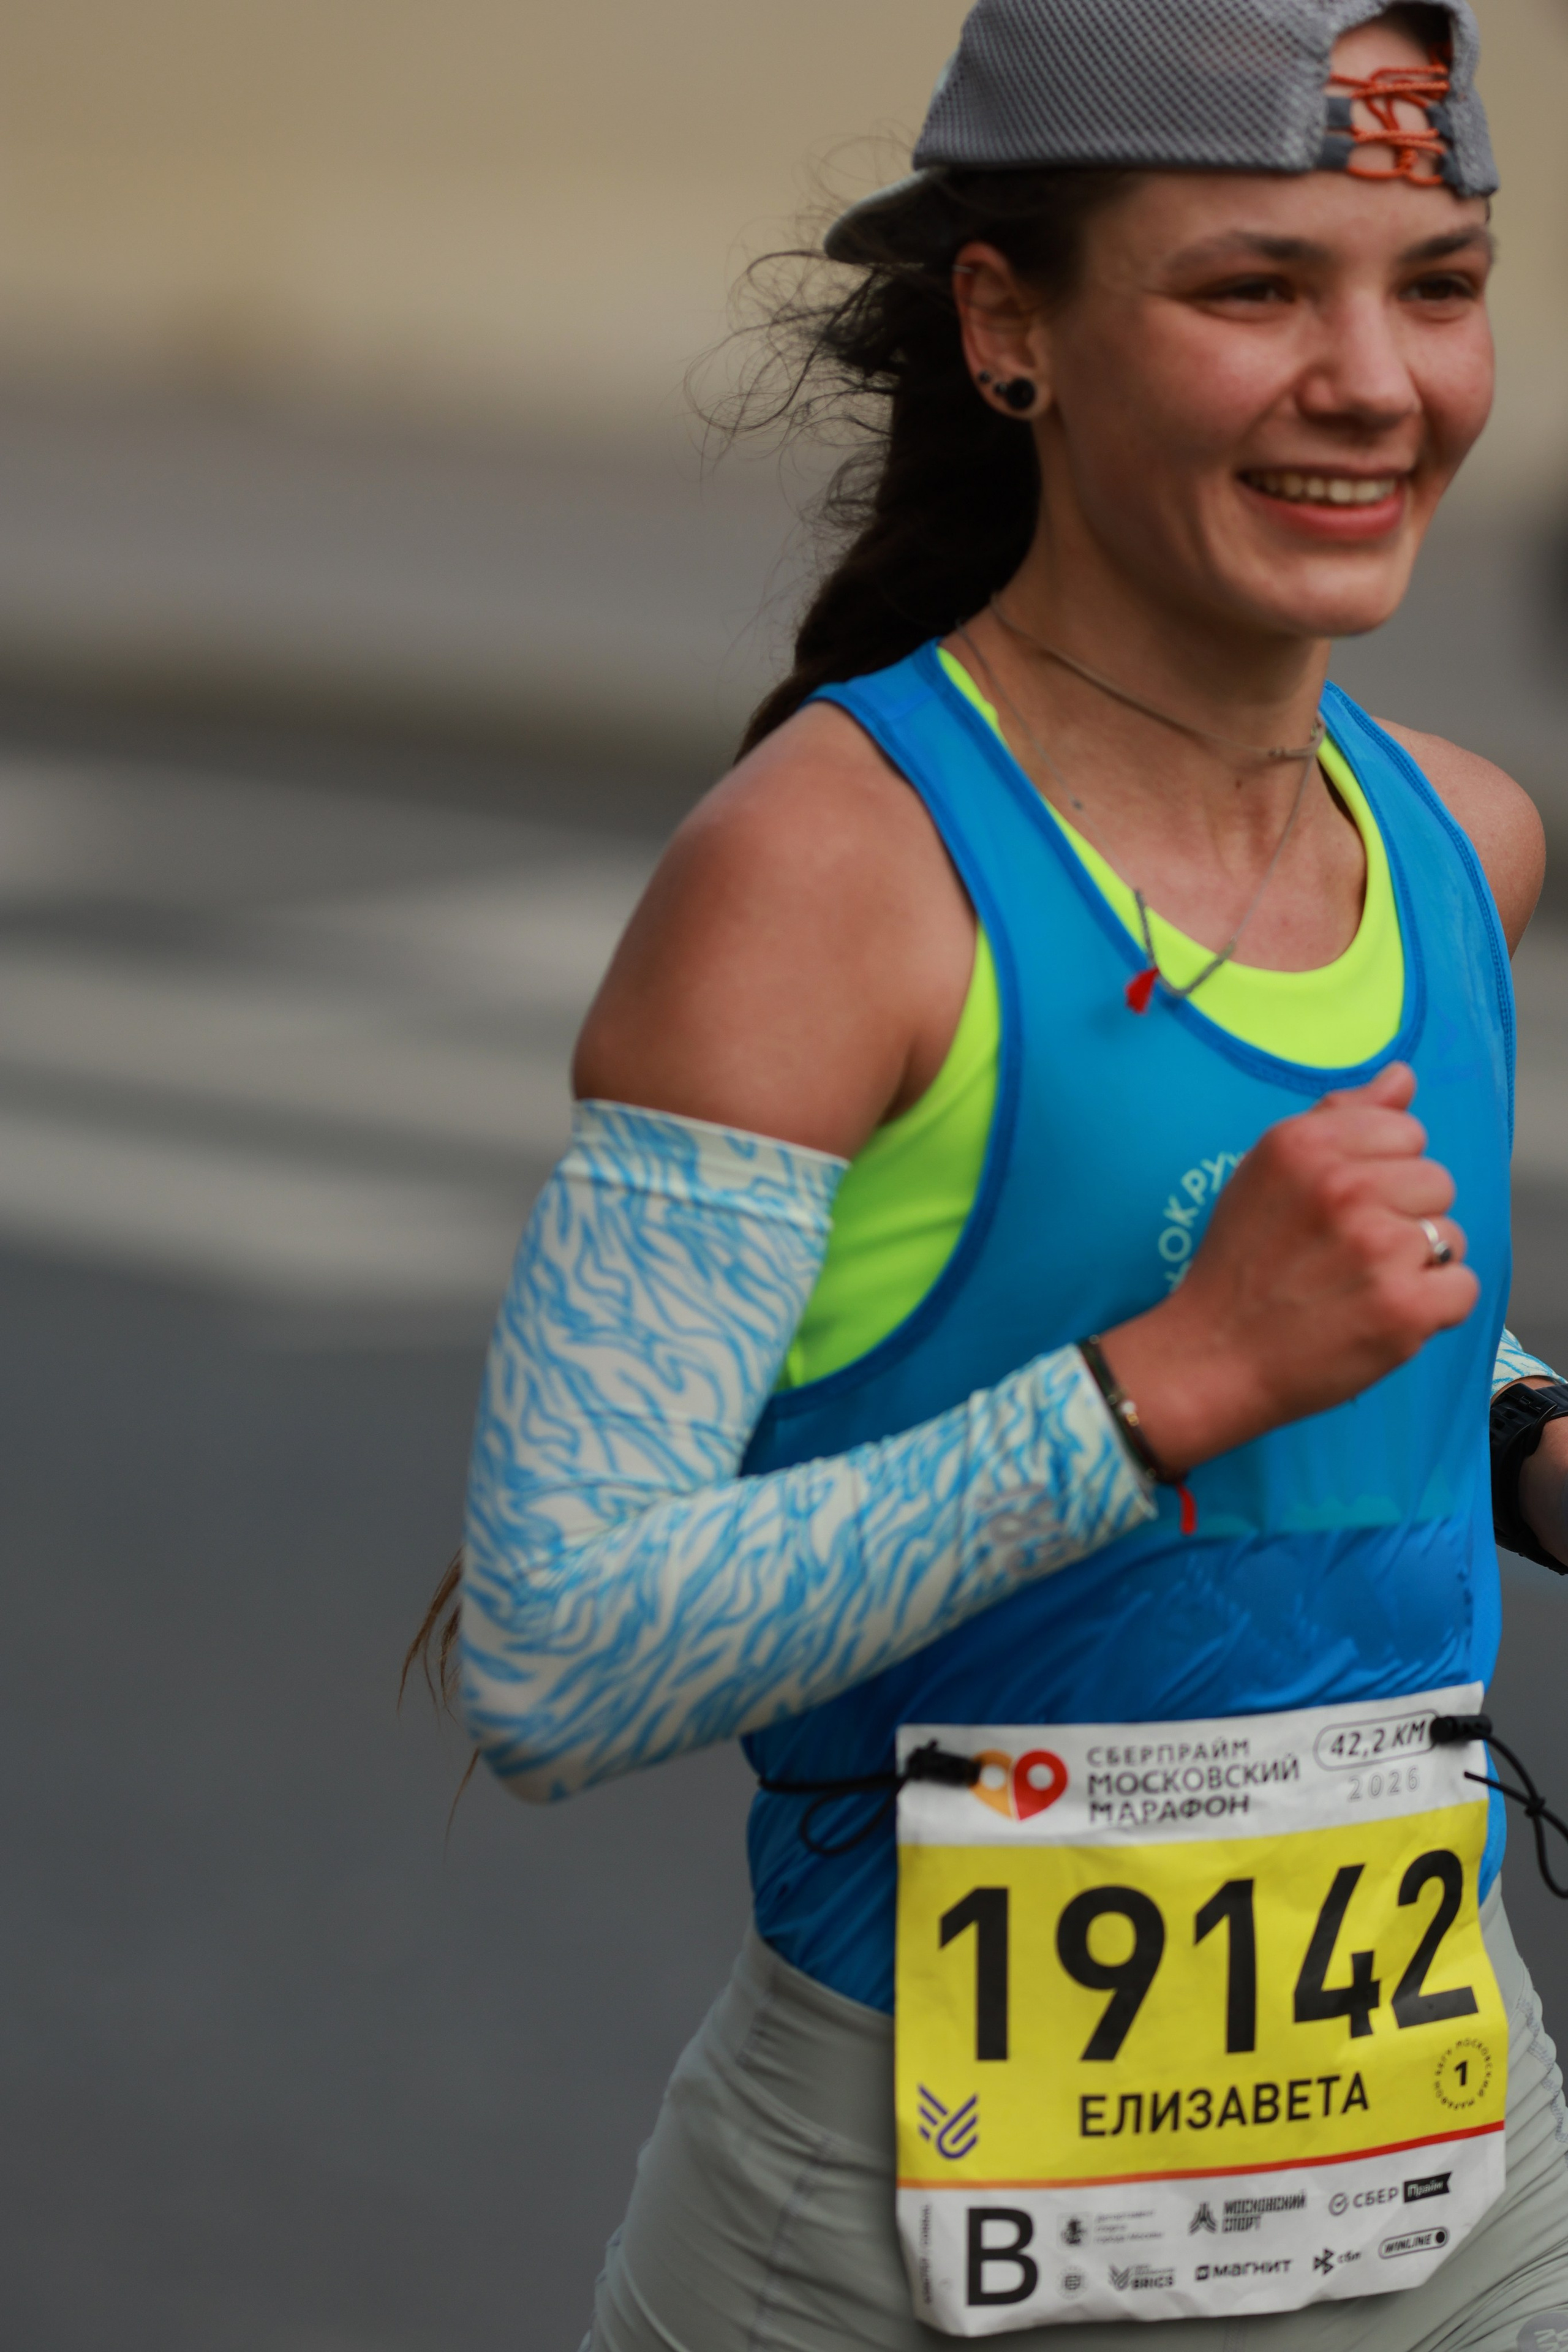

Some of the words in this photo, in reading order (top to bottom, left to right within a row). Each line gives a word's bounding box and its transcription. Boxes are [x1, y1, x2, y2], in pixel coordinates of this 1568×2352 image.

[1330, 1727, 1385, 1758] 42,2
[1391, 1717, 1427, 1748] КМ
[1086, 1738, 1250, 1768] СБЕРПРАЙМ
[1087, 1754, 1300, 1797] МОСКОВСКИЙ
[1349, 1765, 1419, 1803] 2026
[1088, 1795, 1250, 1825] МАРАФОН
[937, 1847, 1480, 2063] 19142
[1453, 2059, 1468, 2087] 1
[1079, 2072, 1371, 2138] ЕЛИЗАВЕТА
[1223, 2189, 1307, 2216] МОСКОВСКИЙ
[1352, 2186, 1400, 2208] СБЕР
[1407, 2180, 1444, 2198] Прайм
[1222, 2215, 1262, 2234] СПОРТ
[1384, 2233, 1433, 2255] WINLINE
